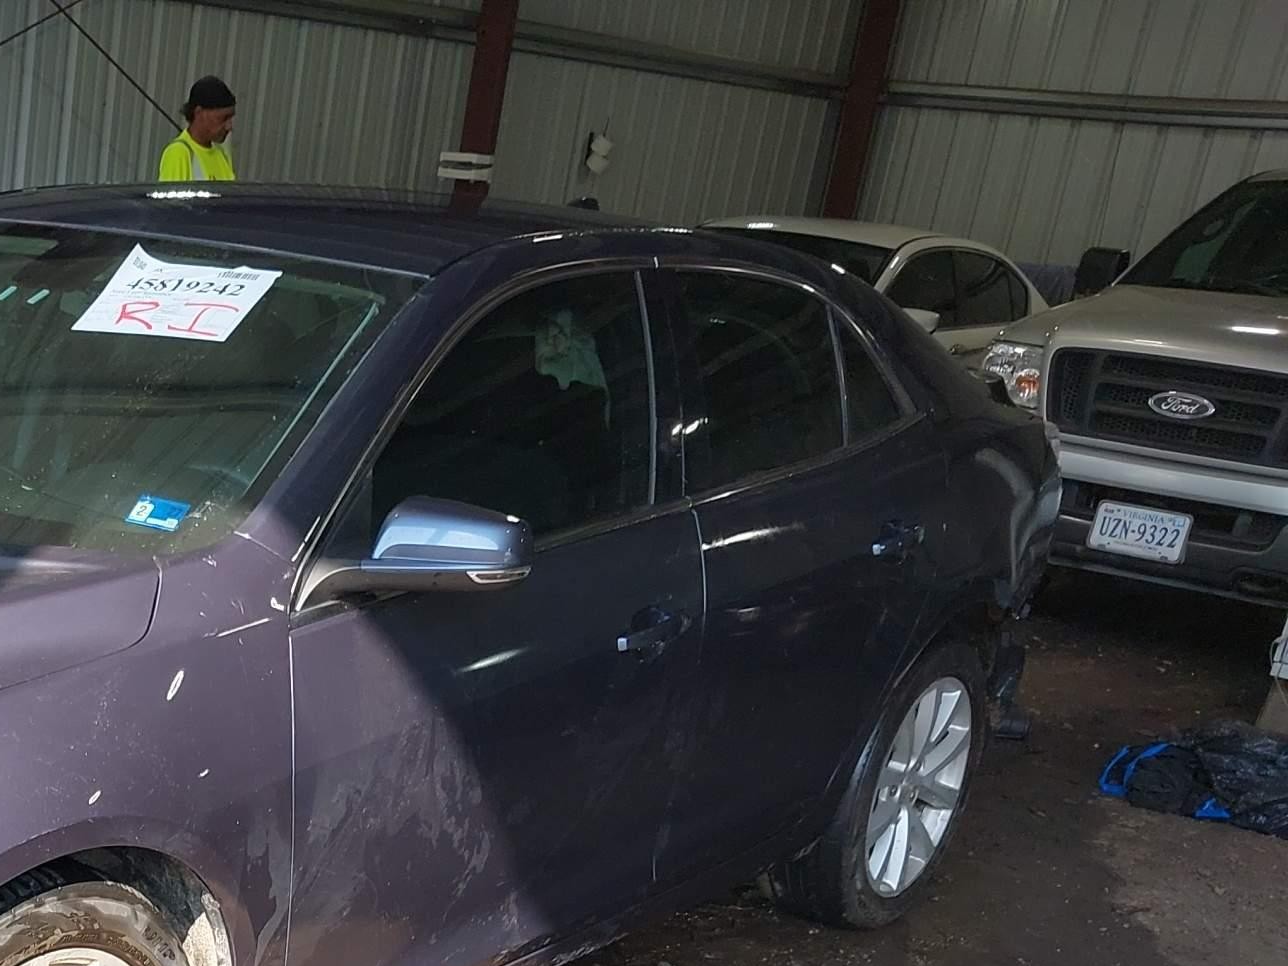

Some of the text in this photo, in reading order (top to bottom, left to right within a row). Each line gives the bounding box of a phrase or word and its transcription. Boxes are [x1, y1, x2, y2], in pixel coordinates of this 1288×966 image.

[126, 276, 246, 297] 45819242
[1160, 396, 1198, 415] Ford
[1123, 510, 1165, 525] VIRGINIA
[1099, 515, 1181, 549] UZN-9322
